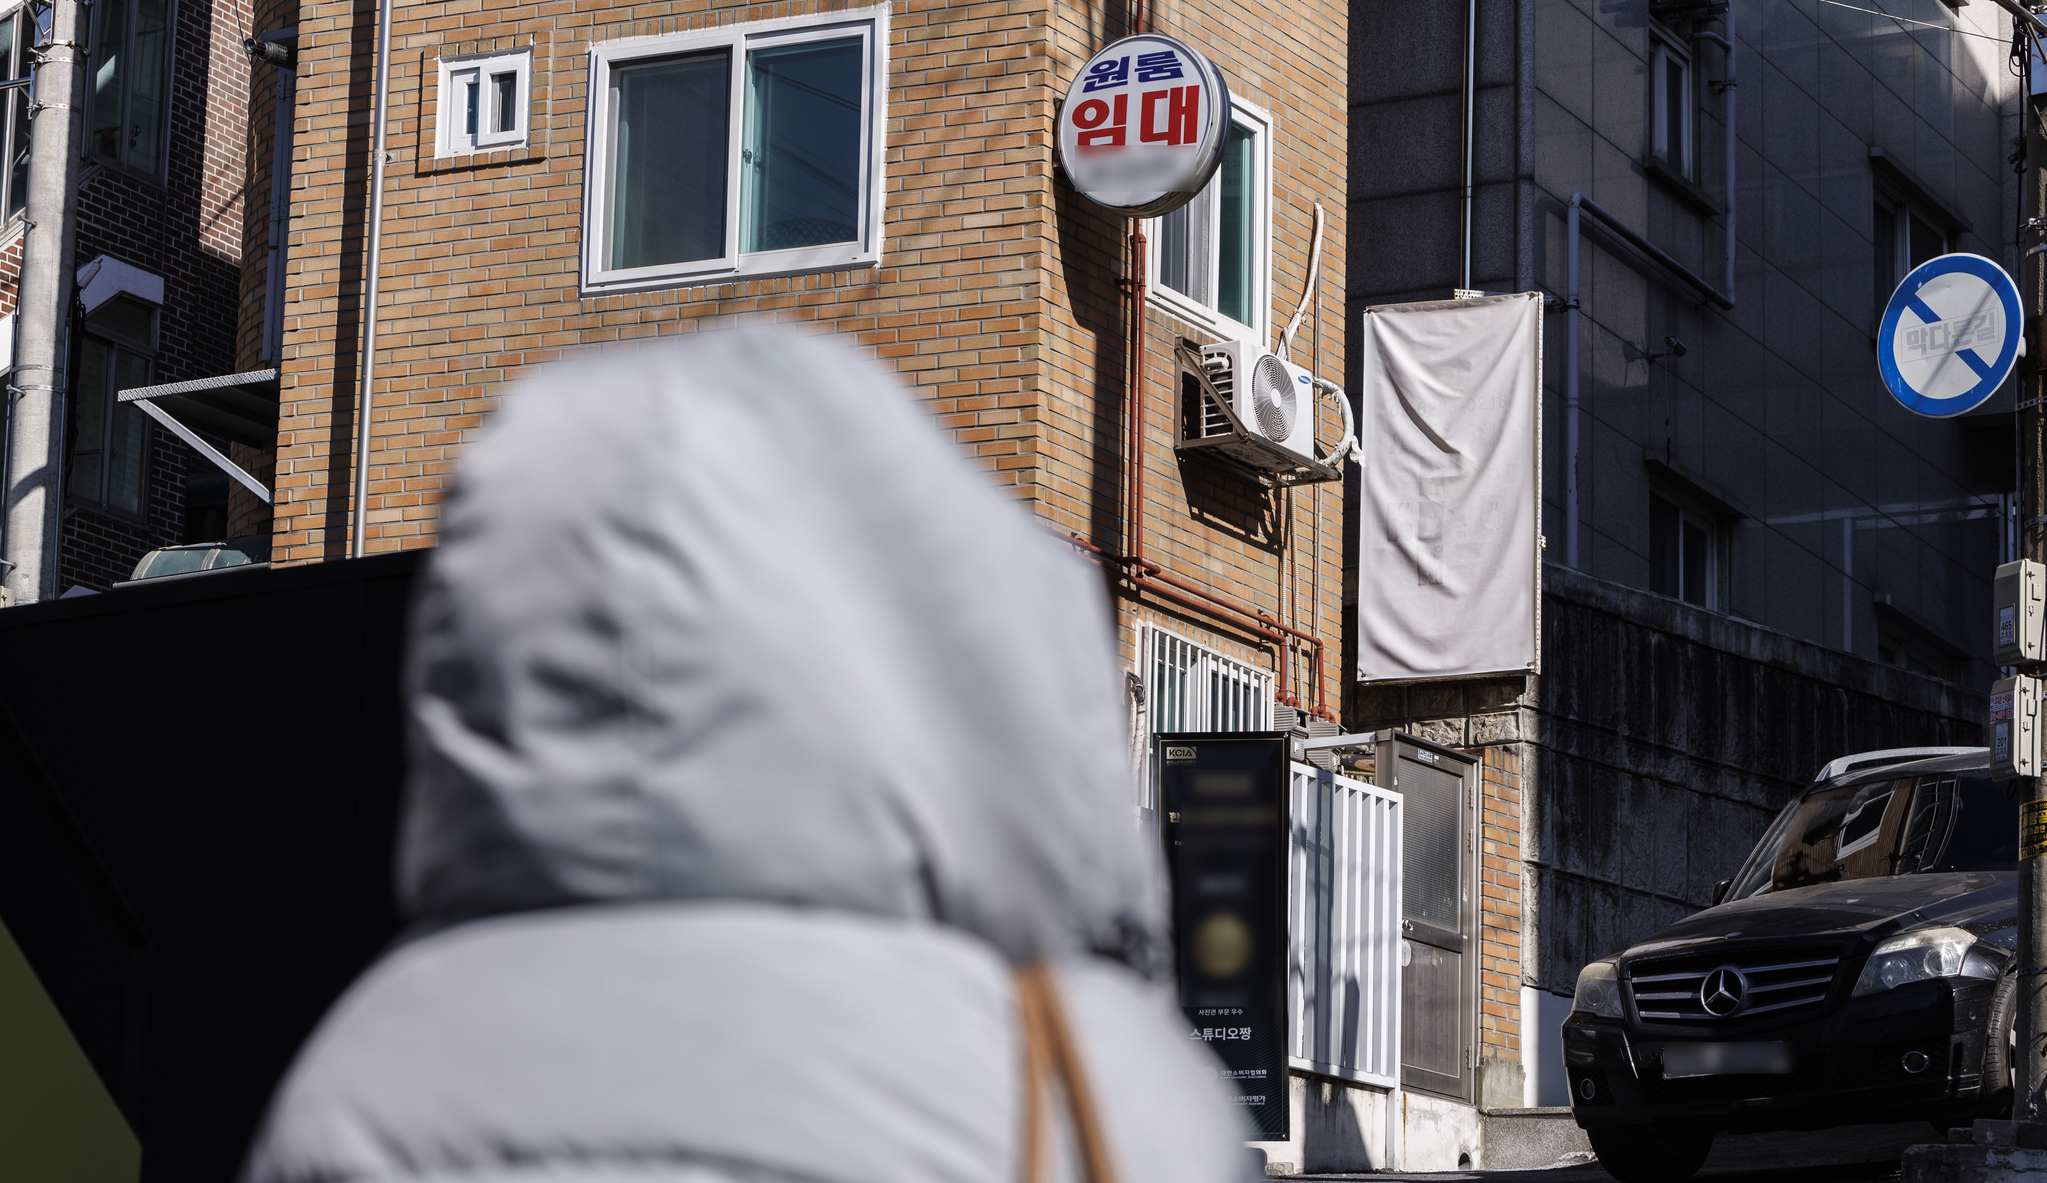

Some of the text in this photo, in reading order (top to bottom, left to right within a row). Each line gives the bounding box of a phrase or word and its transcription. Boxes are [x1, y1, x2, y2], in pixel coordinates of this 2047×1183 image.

[1082, 50, 1185, 94] 원룸
[1071, 85, 1200, 147] 임대
[1906, 311, 1996, 356] 막다른길
[2001, 620, 2012, 632] 465
[1996, 736, 2007, 748] 201
[1169, 748, 1193, 757] KCIA
[1198, 1008, 1244, 1016] 사진관 부문 우수
[1189, 1027, 1252, 1041] 스튜디오짱
